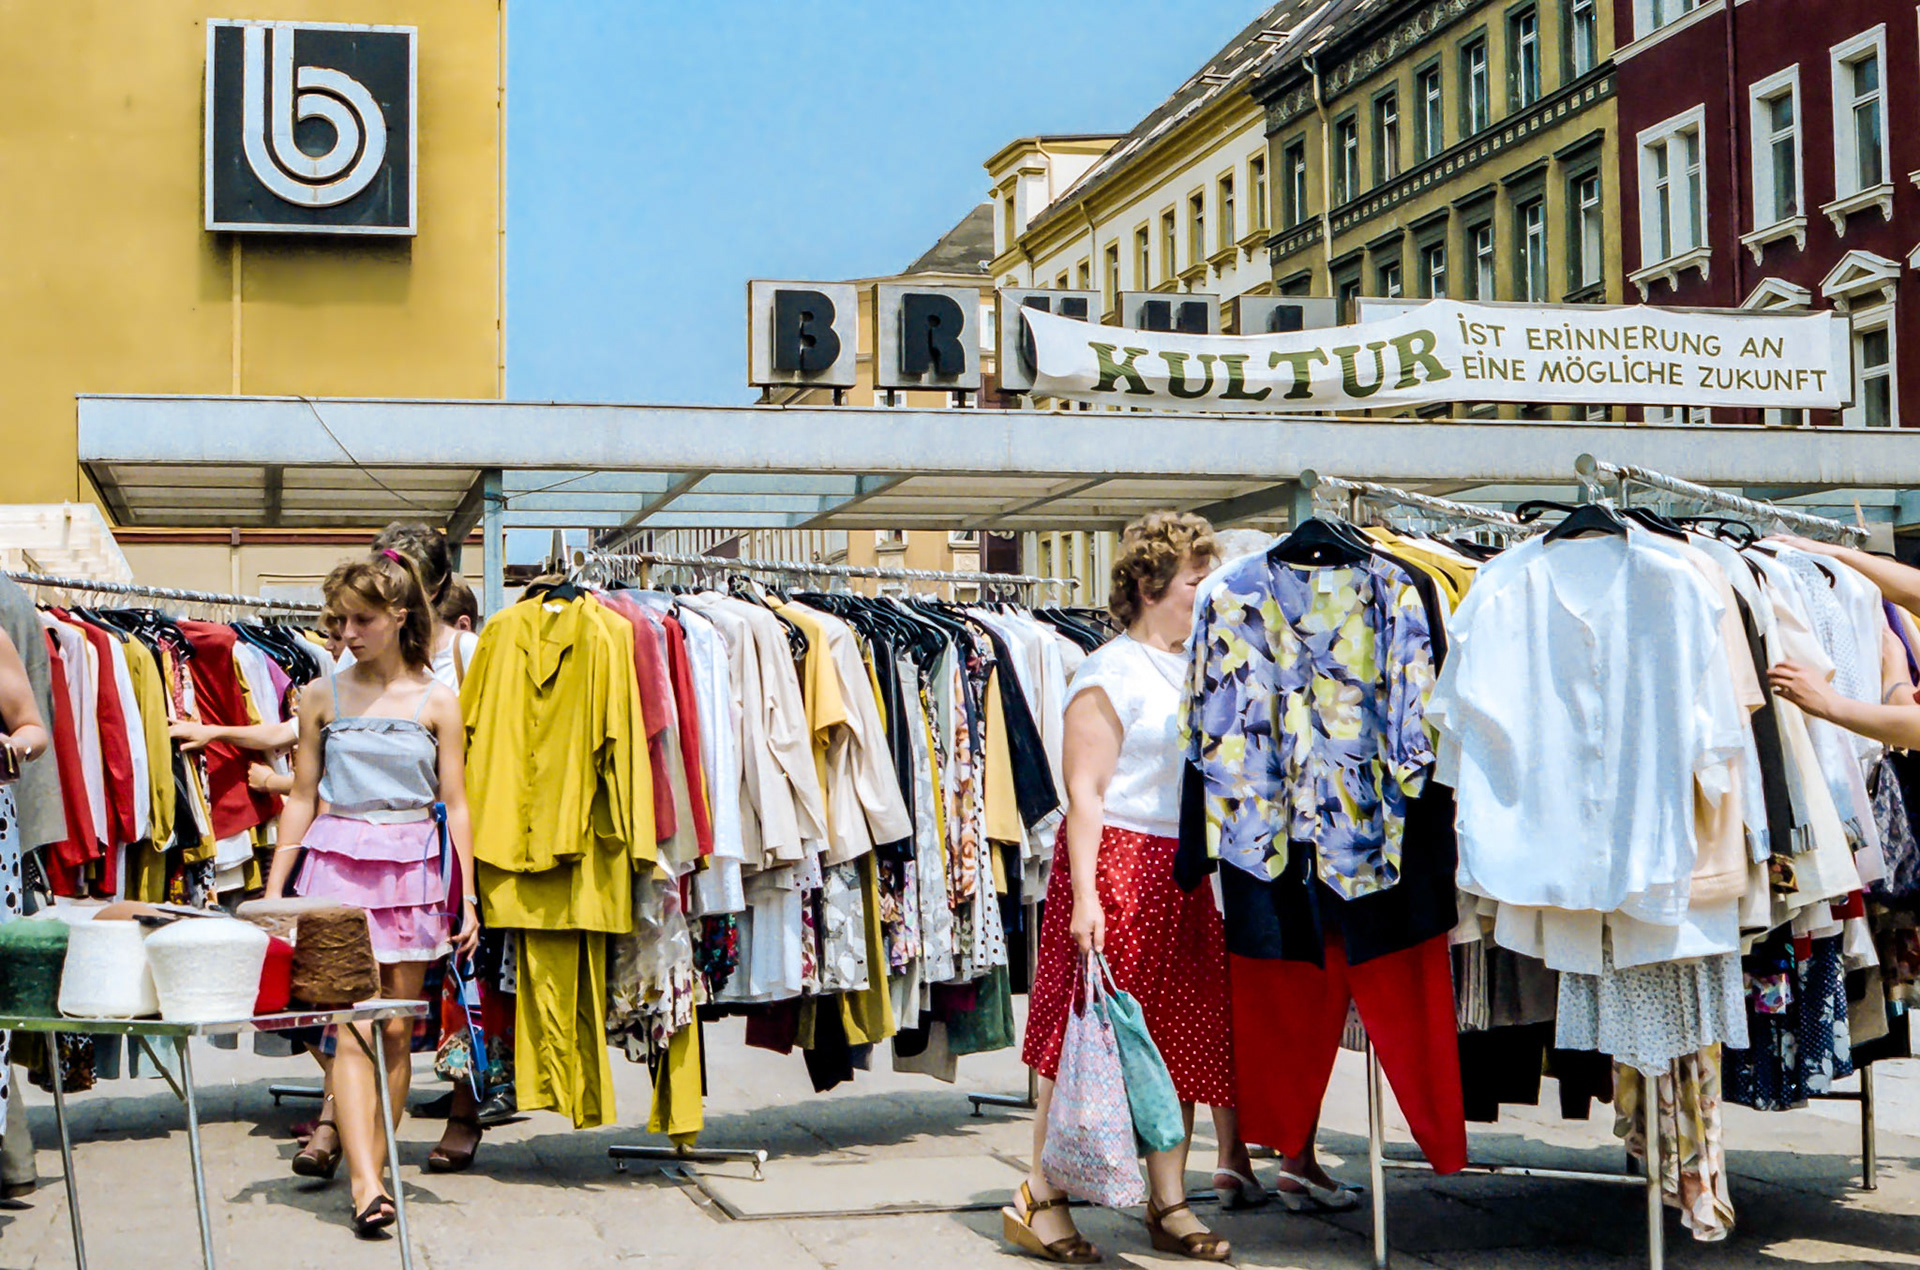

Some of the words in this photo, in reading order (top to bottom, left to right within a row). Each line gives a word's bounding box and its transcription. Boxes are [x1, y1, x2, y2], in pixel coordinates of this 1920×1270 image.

[1739, 336, 1784, 359] AN
[1088, 329, 1452, 400] KULTUR
[1698, 365, 1827, 392] ZUKUNFT
